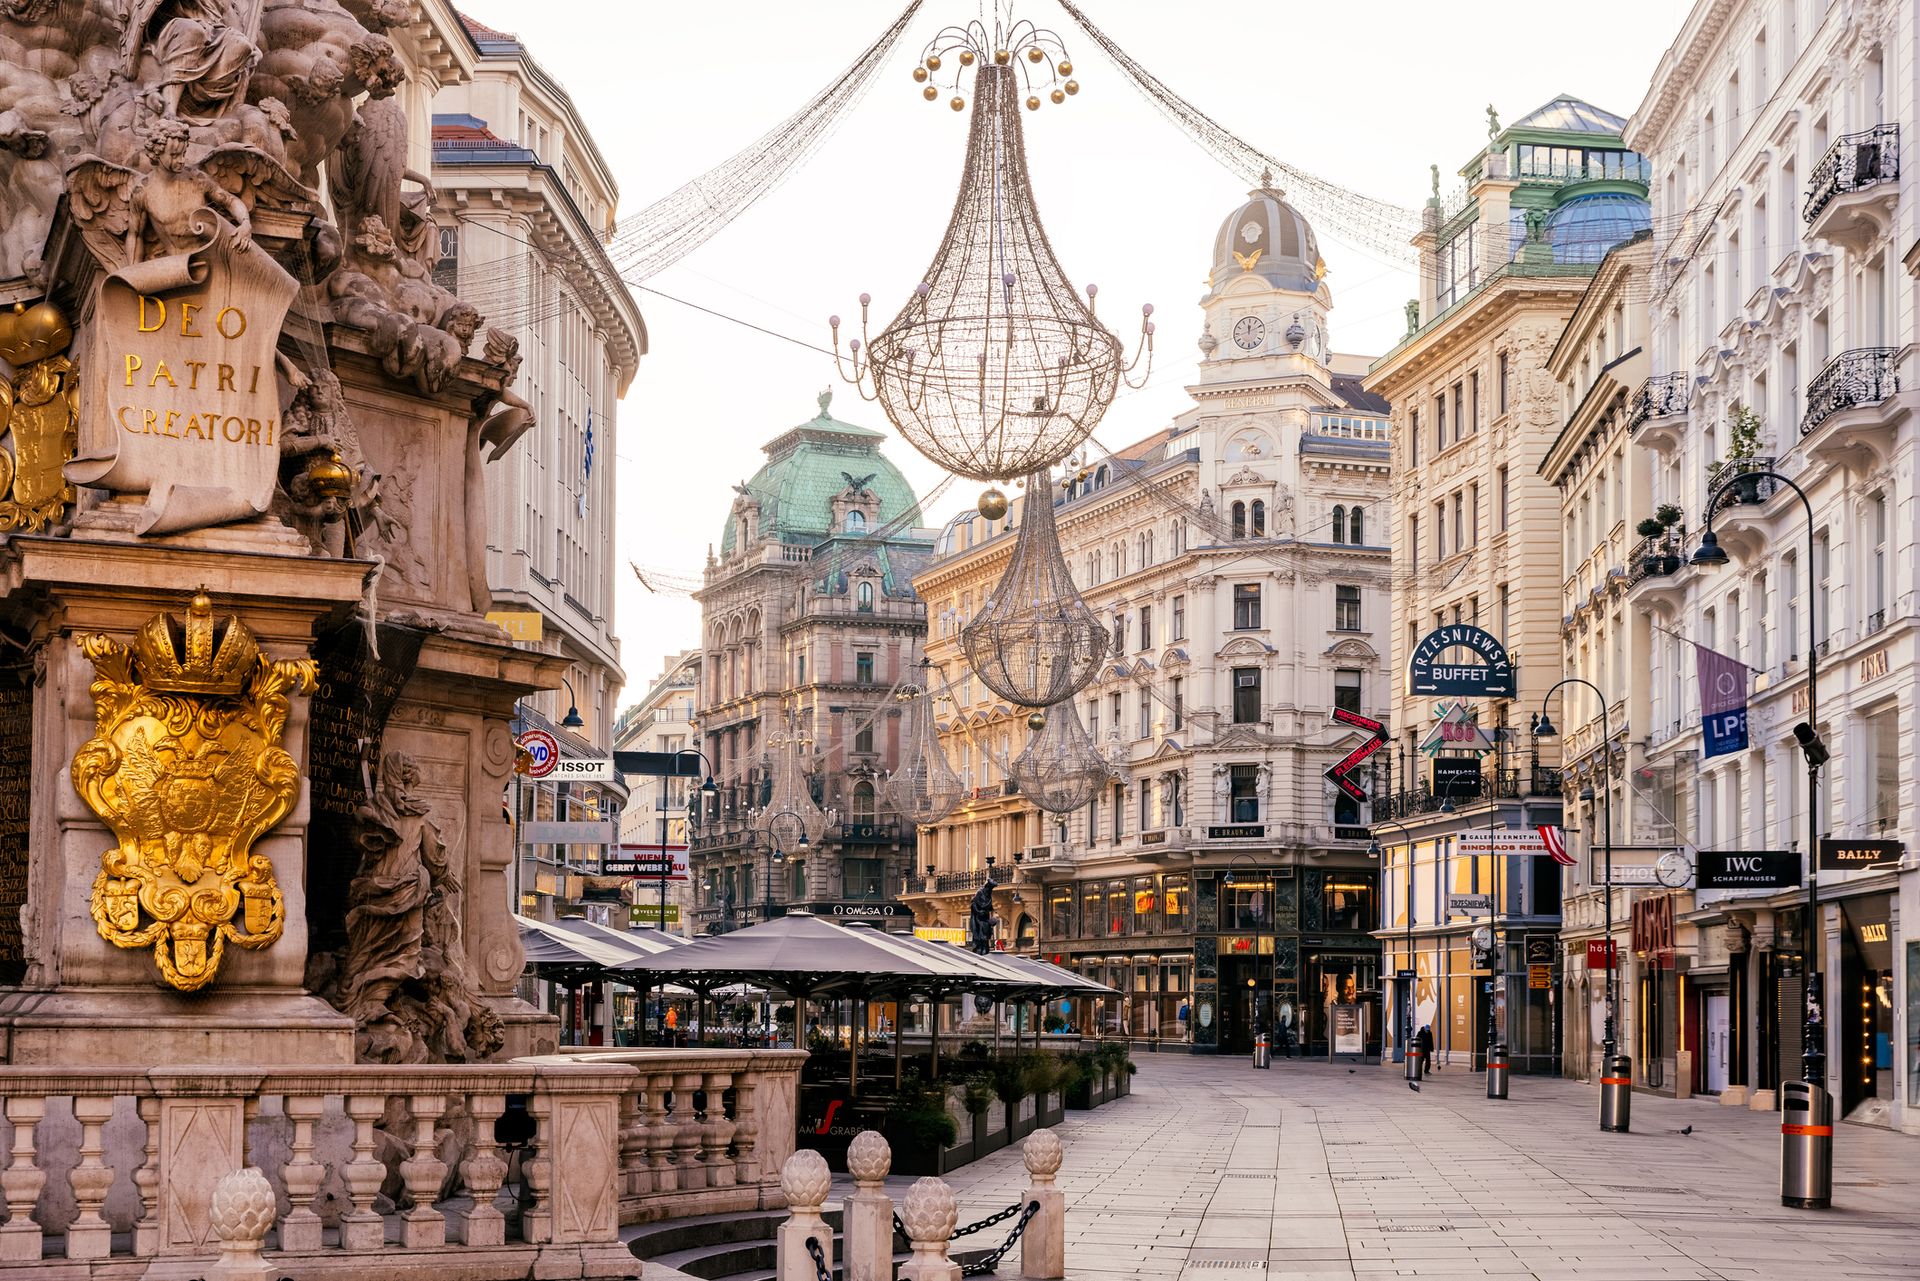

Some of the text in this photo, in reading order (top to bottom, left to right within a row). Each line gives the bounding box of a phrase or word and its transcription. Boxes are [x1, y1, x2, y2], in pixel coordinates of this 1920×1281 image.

[138, 295, 247, 339] DEO
[124, 354, 261, 394] PATRI
[118, 405, 275, 446] CREATORI
[1432, 667, 1489, 681] BUFFET
[1334, 738, 1383, 777] FLEDERMAUS
[554, 762, 605, 772] TISSOT
[1837, 849, 1882, 860] BALLY
[605, 863, 635, 872] GERRY
[636, 863, 669, 872] WEBER
[1726, 856, 1763, 873] IWC
[1631, 892, 1676, 952] LISKA
[1859, 923, 1888, 943] BALLY
[798, 1125, 871, 1136] AM GRABE
